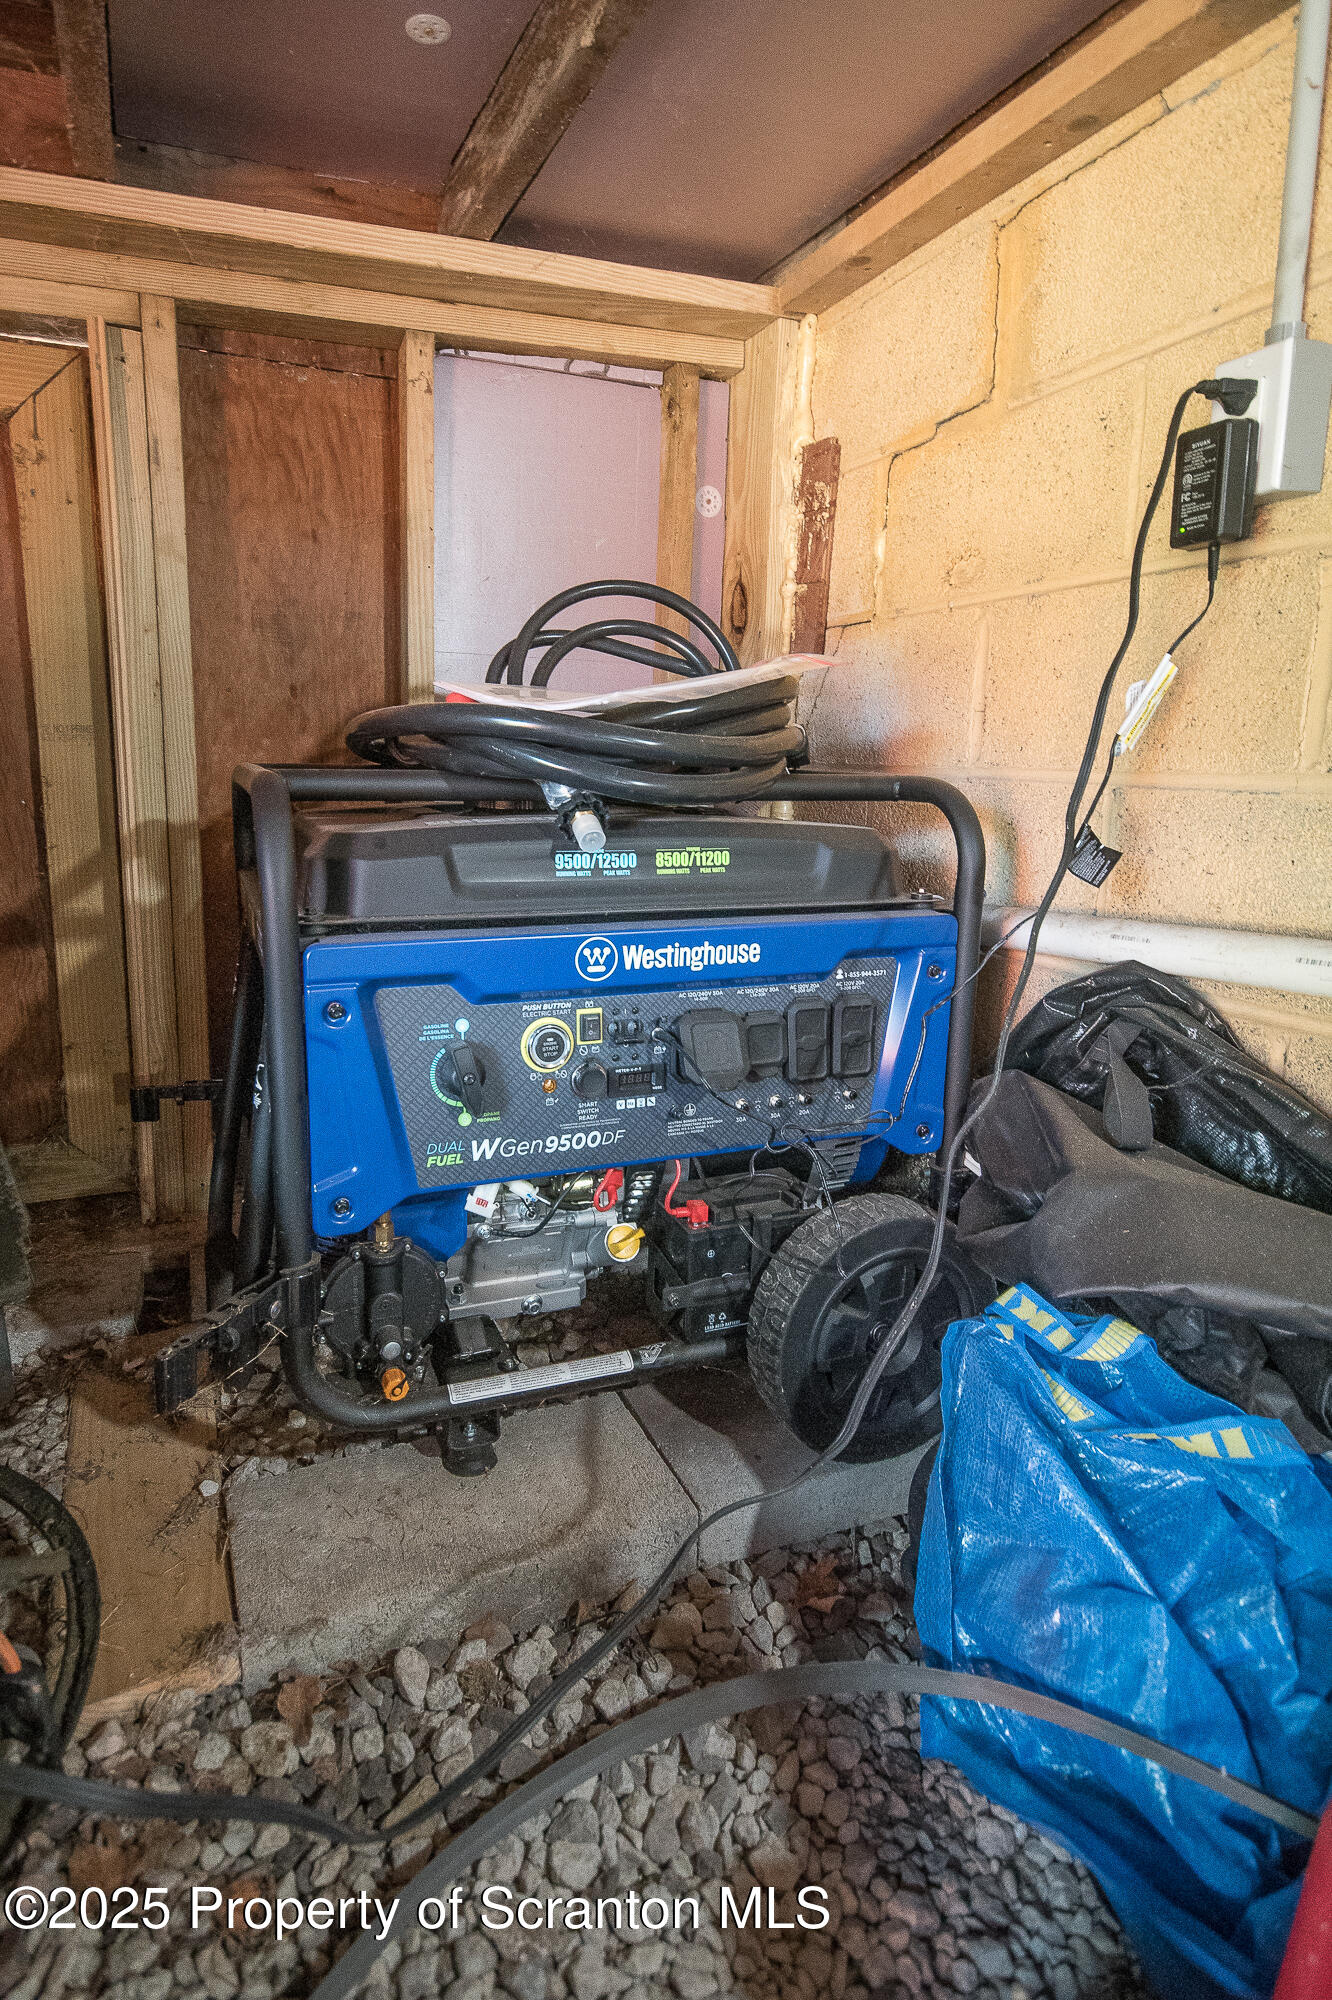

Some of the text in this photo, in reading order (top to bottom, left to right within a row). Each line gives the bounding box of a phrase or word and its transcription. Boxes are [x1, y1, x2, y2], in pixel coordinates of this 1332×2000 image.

[554, 853, 637, 870] 9500/12500
[656, 850, 730, 868] 8500/11200
[622, 942, 761, 971] Westinghouse
[426, 1142, 466, 1155] DUAL
[426, 1154, 464, 1168] FUEL
